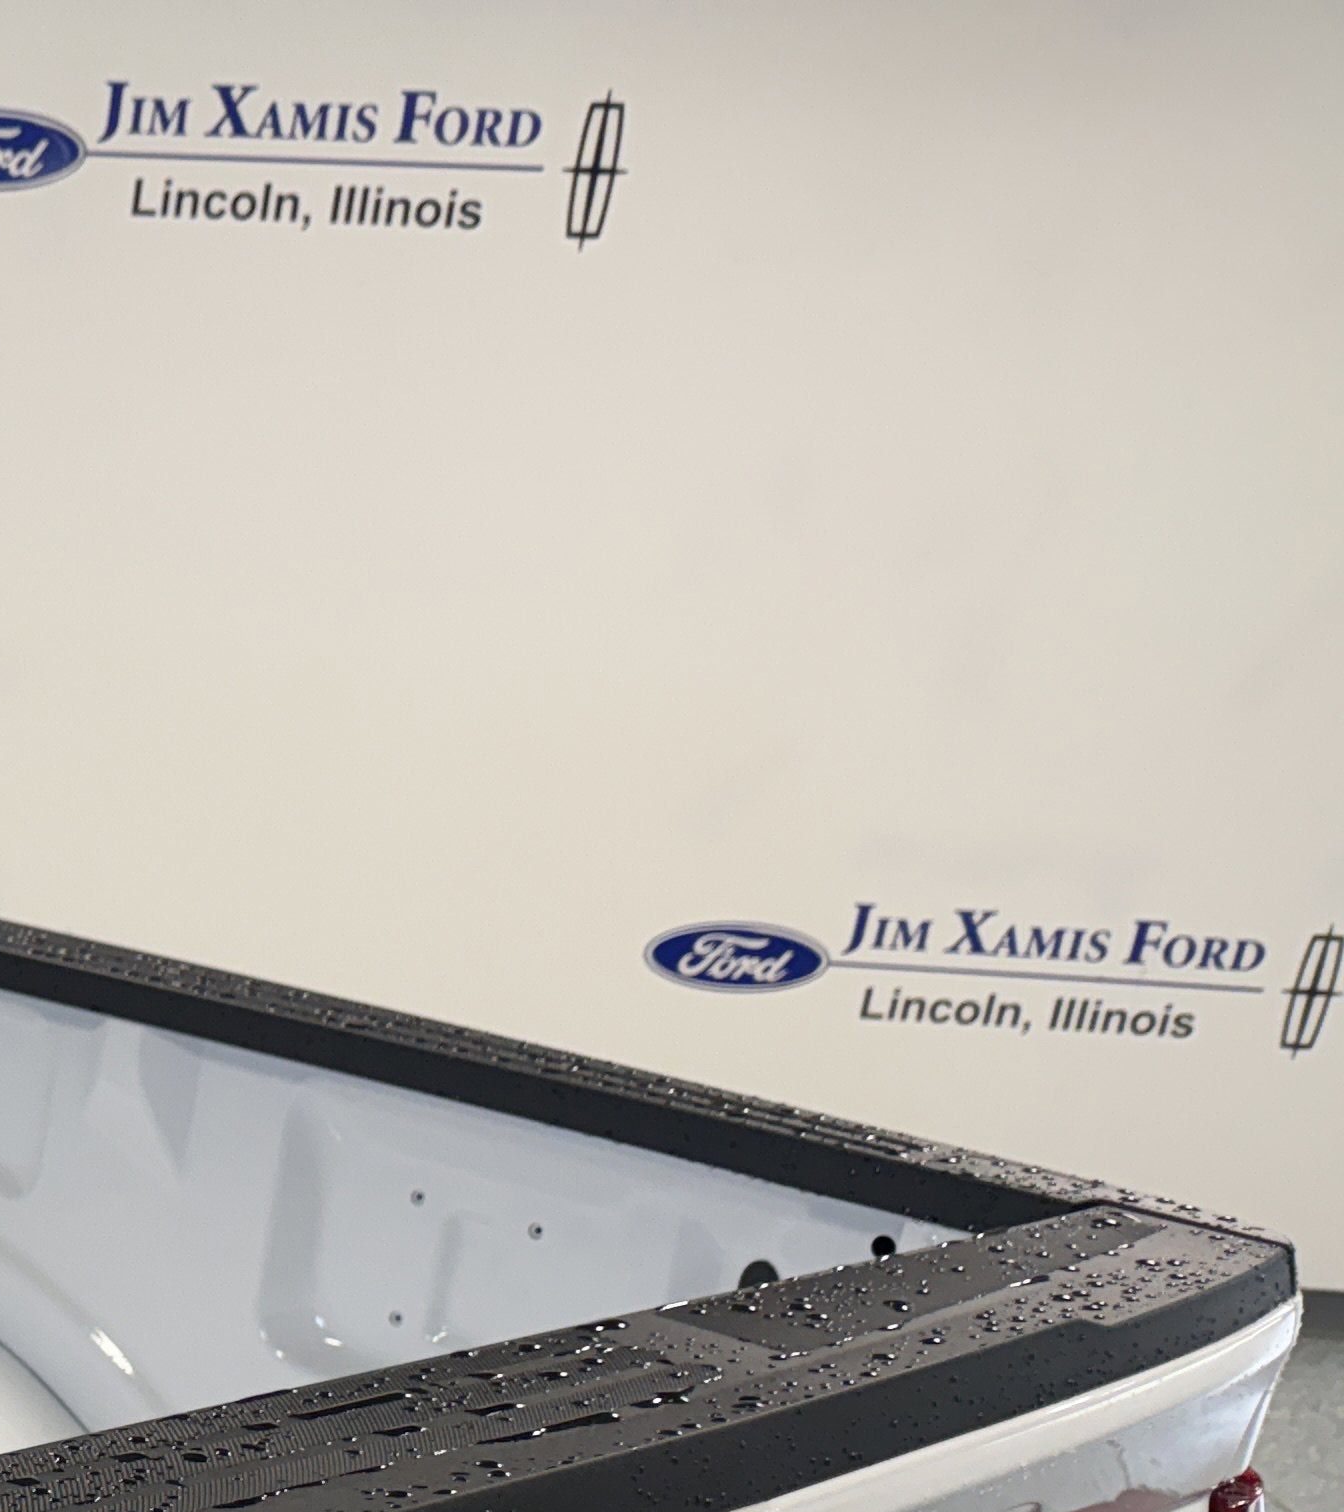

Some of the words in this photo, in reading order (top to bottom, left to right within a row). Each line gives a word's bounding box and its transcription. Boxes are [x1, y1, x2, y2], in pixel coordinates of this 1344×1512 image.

[97, 80, 191, 144] JIM
[204, 83, 379, 143] XAMIS
[393, 89, 543, 148] FORD
[130, 177, 312, 229] Lincoln,
[329, 184, 483, 231] Illinois
[676, 931, 794, 985] Ford
[842, 902, 933, 956] JIM
[944, 909, 1110, 963] XAMIS
[1124, 919, 1267, 972] FORD
[858, 986, 1032, 1034] Lincoln,
[1048, 996, 1196, 1040] Illinois
